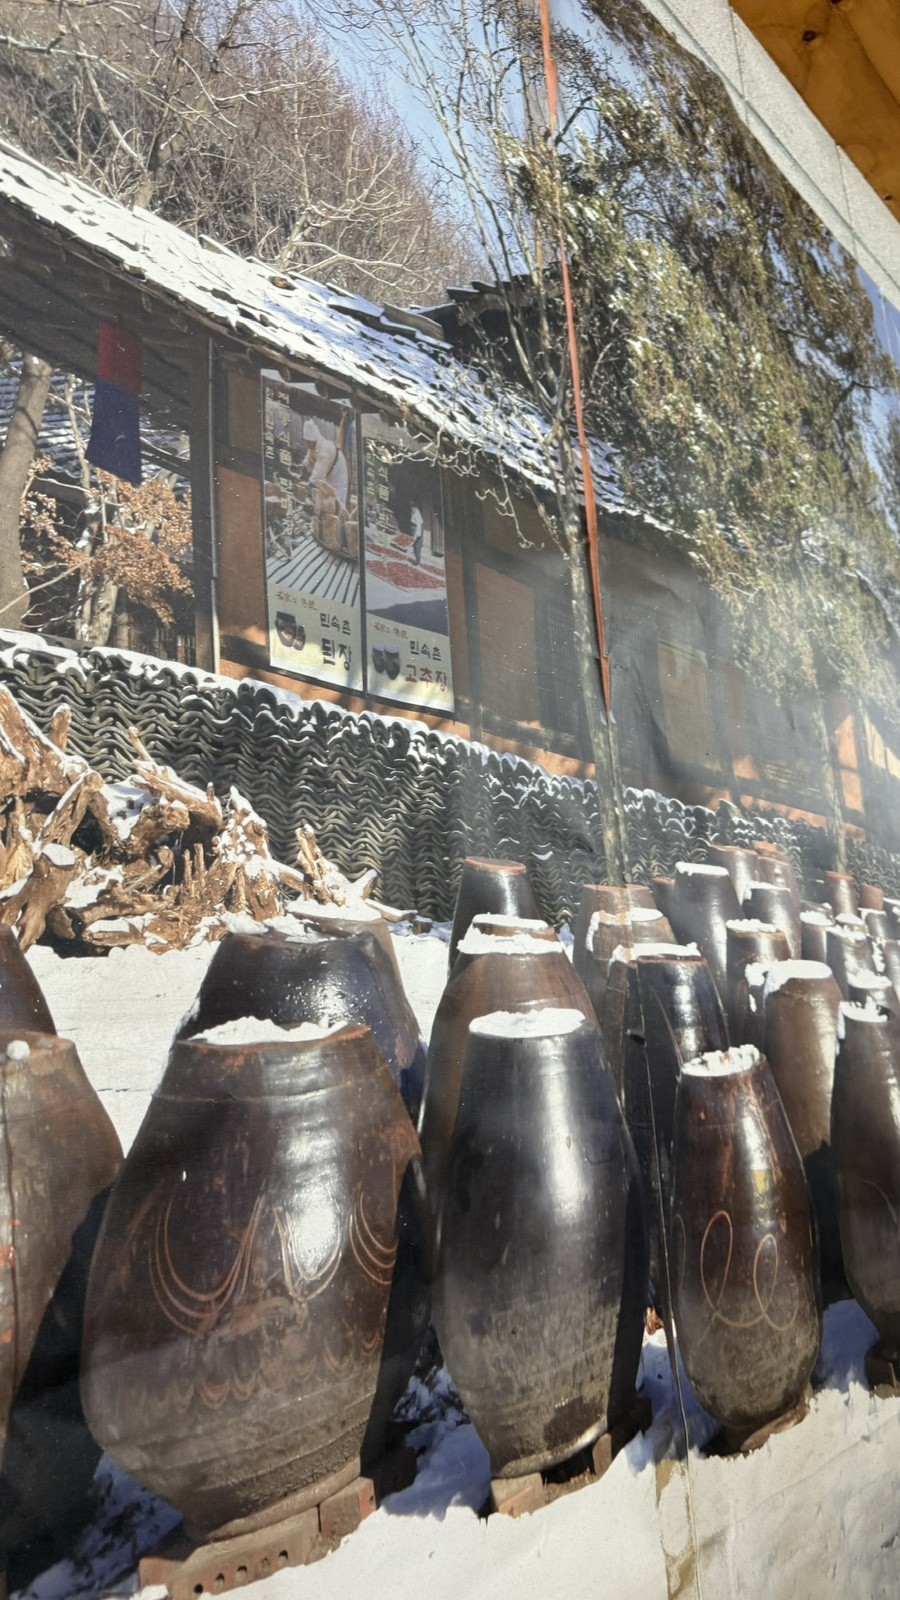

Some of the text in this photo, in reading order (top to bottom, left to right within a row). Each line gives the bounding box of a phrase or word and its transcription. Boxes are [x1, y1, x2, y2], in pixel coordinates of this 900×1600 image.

[278, 391, 292, 467] 전통식품
[320, 612, 352, 636] 민속촌
[321, 638, 353, 672] 된장
[409, 640, 442, 662] 민속촌
[404, 664, 448, 693] 고추장
